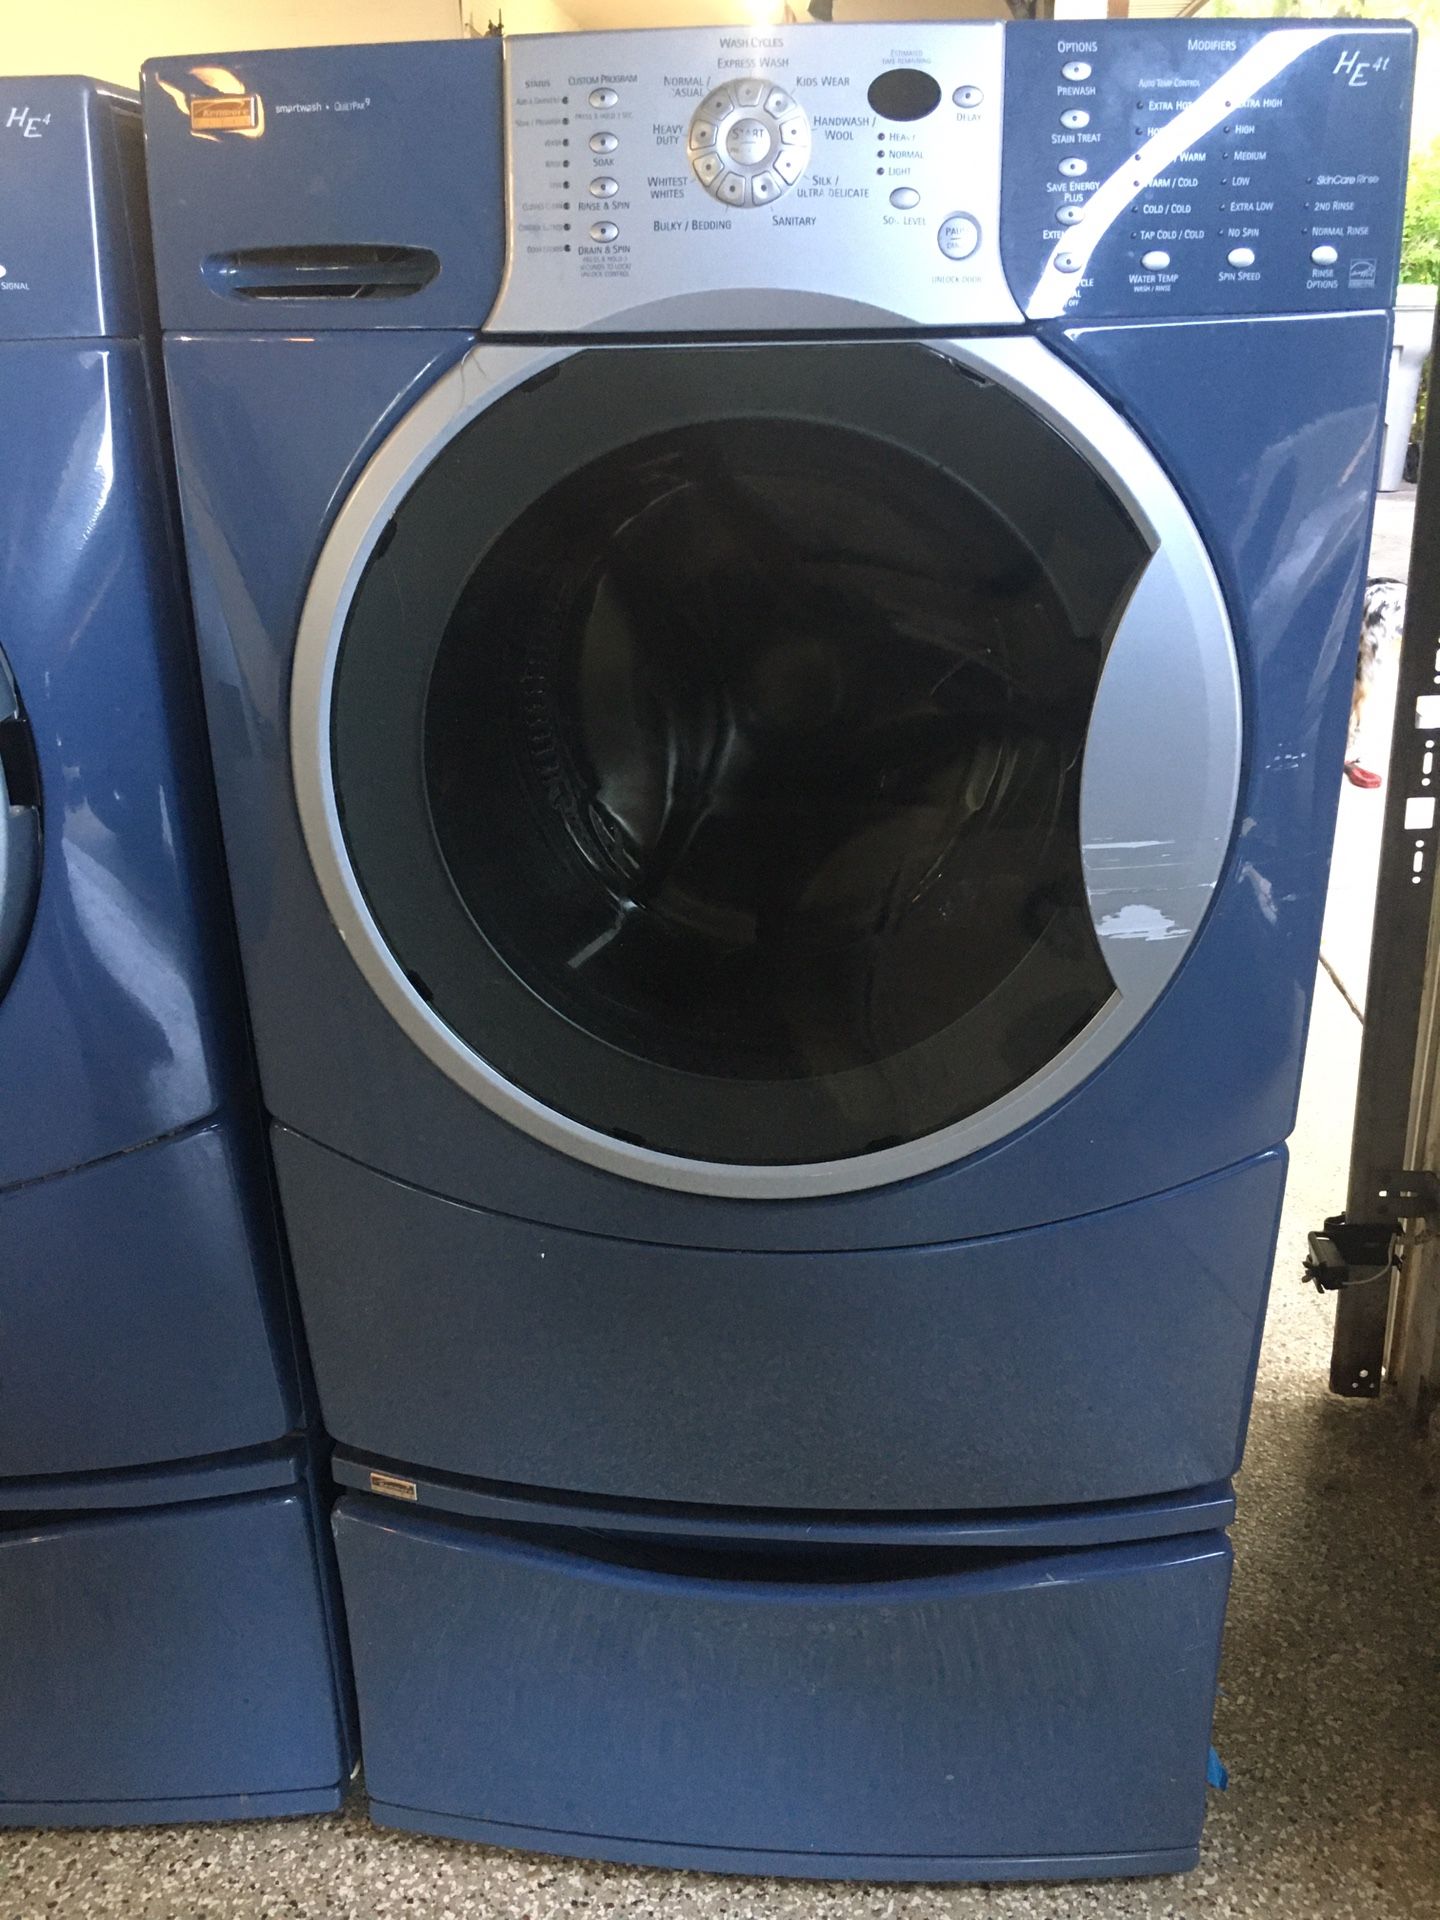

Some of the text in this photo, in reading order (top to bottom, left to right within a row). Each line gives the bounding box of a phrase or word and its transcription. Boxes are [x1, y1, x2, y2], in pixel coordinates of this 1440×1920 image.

[720, 38, 785, 48] WASH CYCLES
[1057, 41, 1098, 53] OPTIONS
[1188, 40, 1237, 51] MODIFIERS
[718, 58, 789, 69] EXPRESS WASH
[568, 74, 638, 86] CUSTOM PROGRAM
[664, 76, 704, 86] NORMAL
[796, 76, 850, 87] KIDS WEAR
[1173, 79, 1200, 88] CONTROL
[673, 89, 704, 98] ASUAL
[1057, 86, 1096, 96] PREWASH
[275, 102, 321, 113] smartwash
[1149, 101, 1173, 111] EXTRA
[1241, 99, 1283, 109] XTRA HIGH
[813, 116, 869, 126] HANDWASH
[653, 125, 684, 134] HEAVY
[825, 129, 854, 140] WOOL
[1147, 127, 1162, 137] HO
[1235, 125, 1255, 134] HIGH
[656, 136, 680, 145] DUTY
[1051, 133, 1101, 144] STAIN TREAT
[889, 150, 923, 159] NORMAL
[1180, 152, 1207, 162] WARM
[1234, 151, 1267, 161] MEDIUM
[593, 158, 615, 167] SOAK
[889, 167, 912, 176] LIGHT
[648, 177, 688, 187] WHITEST
[813, 176, 832, 186] SILK
[1046, 180, 1100, 192] SAVE ENERGY
[1178, 178, 1199, 187] COLD
[1232, 177, 1251, 186] LOW
[651, 189, 684, 199] WHITES
[797, 188, 870, 198] ULTRA DELICATE
[1064, 193, 1084, 202] PLUS
[578, 202, 602, 210] RINSE
[612, 201, 630, 209] SPIN
[1143, 204, 1163, 214] COLD
[1171, 204, 1192, 213] COLD
[1230, 202, 1274, 212] EXTRA LOW
[1314, 200, 1355, 211] 2ND RINSE
[653, 220, 682, 232] BULKY
[692, 219, 733, 230] BEDDING
[772, 216, 817, 226] SANITARY
[883, 216, 928, 226] SO LEVEL
[1140, 230, 1155, 240] TAP
[1157, 230, 1177, 239] COLD
[1185, 229, 1205, 239] COLD
[1228, 227, 1260, 238] NO SPIN
[1312, 226, 1369, 236] NORMAL RINSE
[578, 247, 603, 255] DRAIN
[1218, 270, 1260, 282] SPIN SPEED
[1312, 268, 1334, 278] RINSE
[1078, 278, 1094, 287] CLE
[1129, 273, 1179, 284] WATER TEMP
[0, 281, 30, 290] SIGNAL
[1306, 280, 1339, 290] OPTIONS
